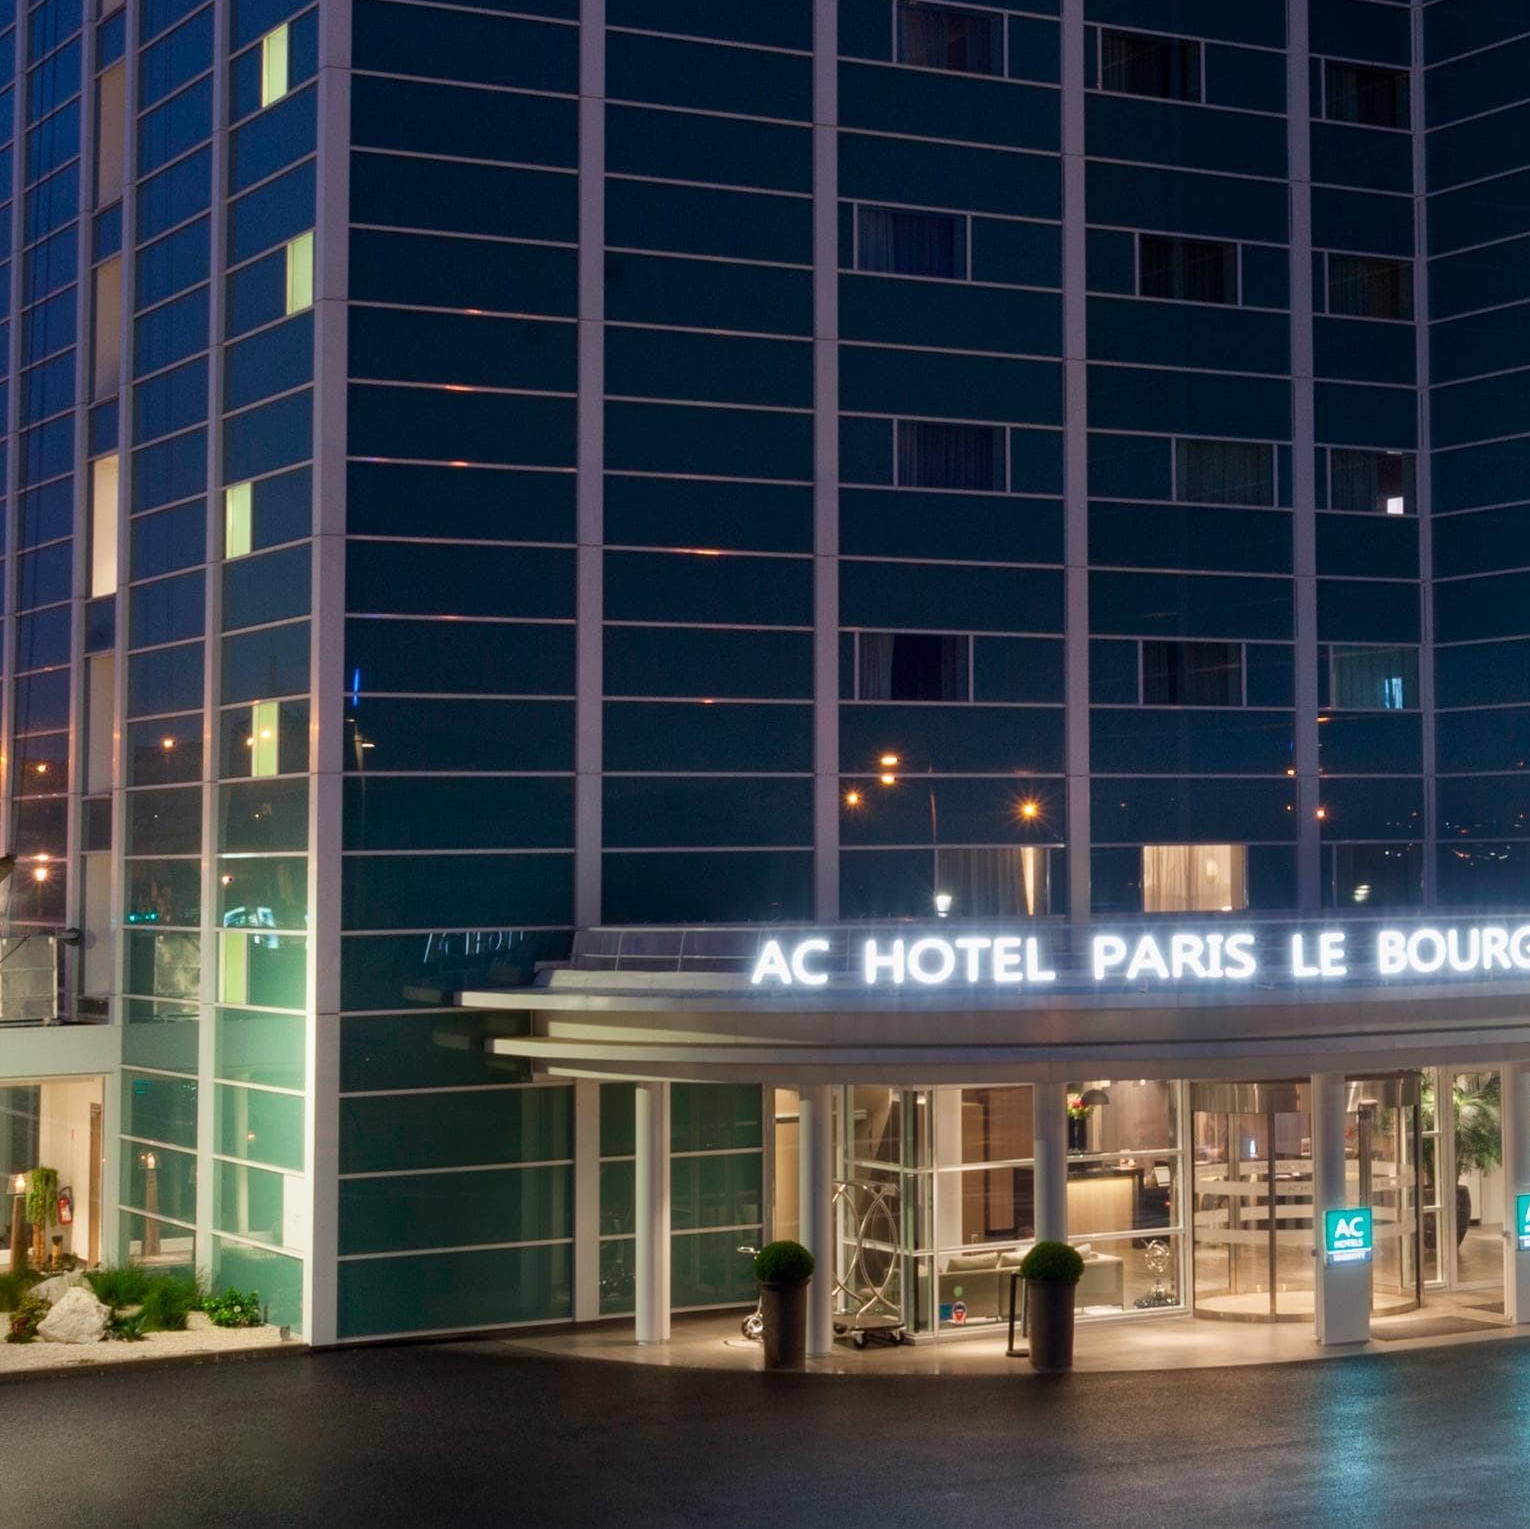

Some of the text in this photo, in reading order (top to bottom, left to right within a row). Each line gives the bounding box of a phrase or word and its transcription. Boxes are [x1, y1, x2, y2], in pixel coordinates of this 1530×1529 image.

[751, 938, 829, 986] AC
[864, 936, 1056, 985] HOTEL
[1092, 933, 1257, 980] PARIS
[1291, 932, 1347, 978] LE
[1334, 1216, 1364, 1238] AC
